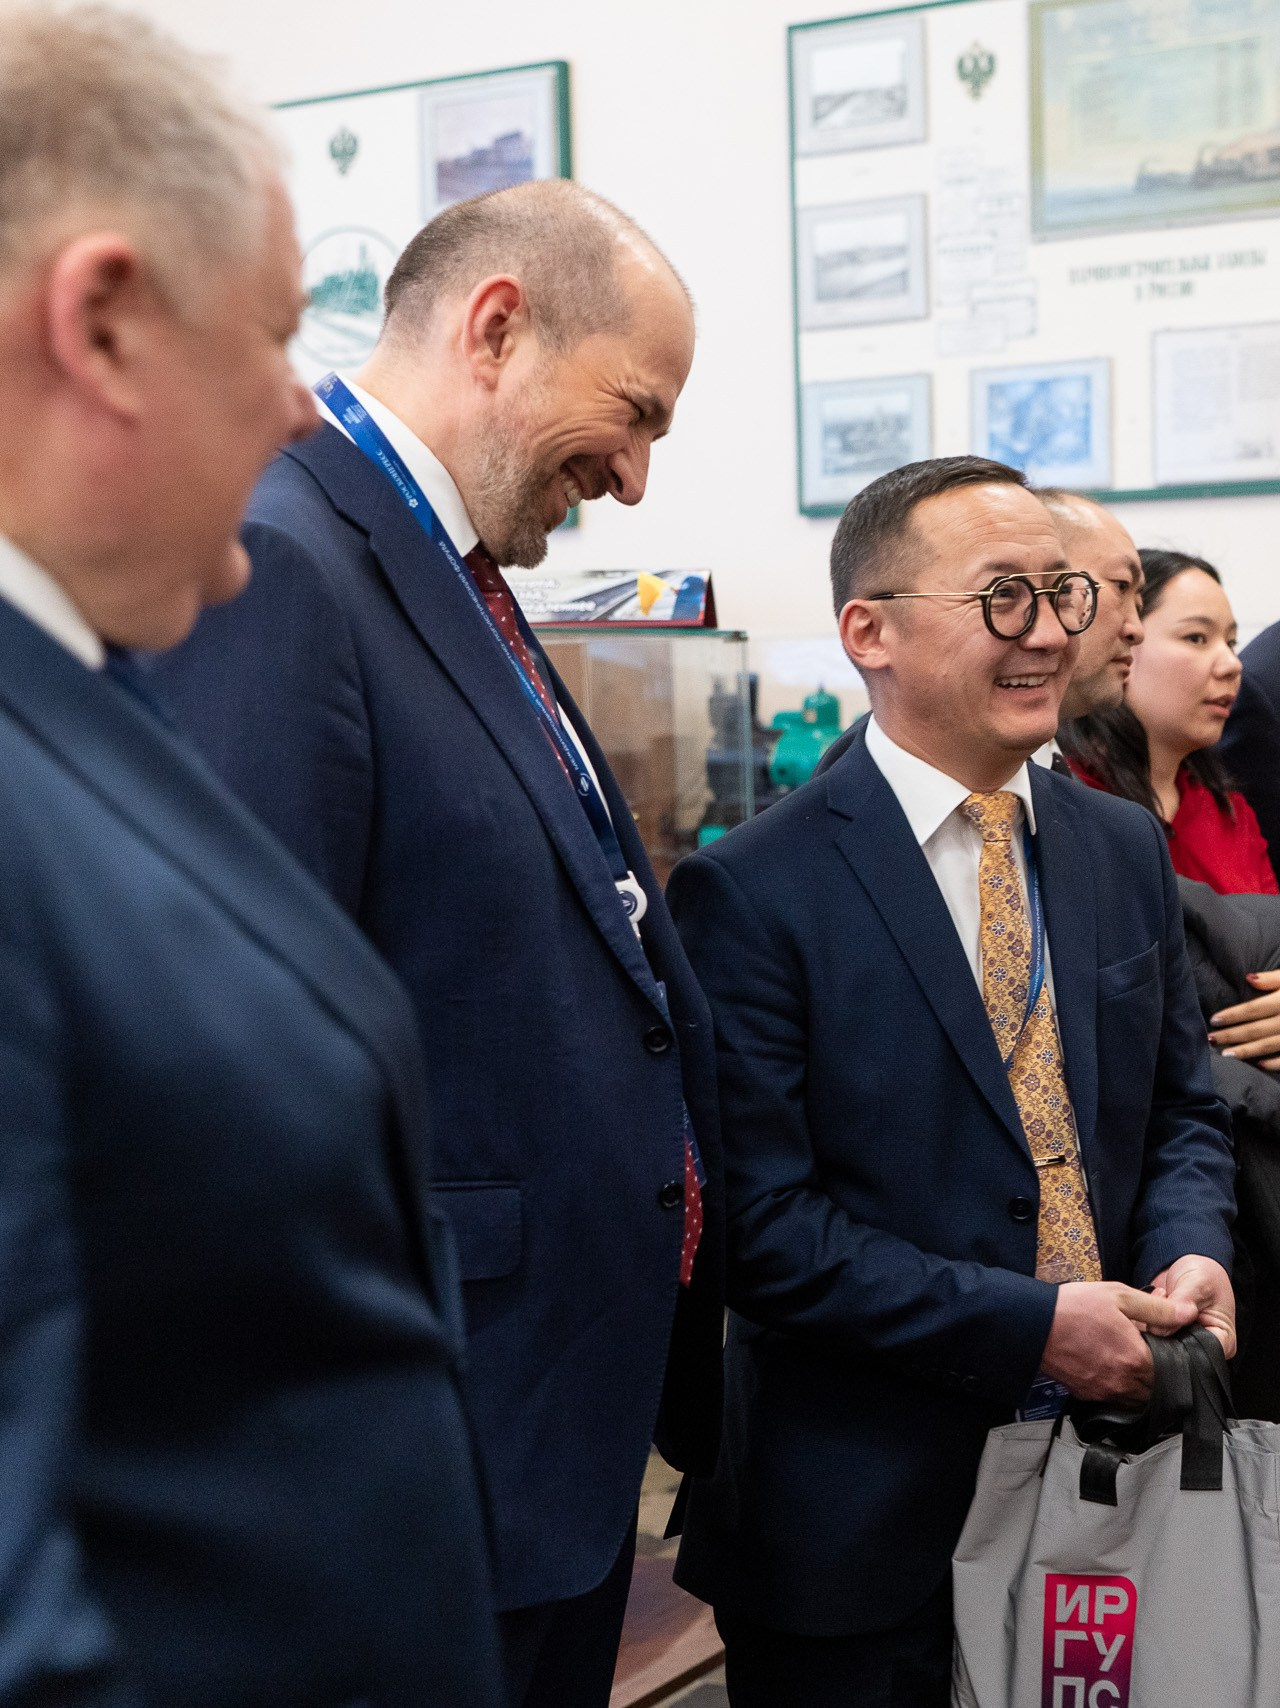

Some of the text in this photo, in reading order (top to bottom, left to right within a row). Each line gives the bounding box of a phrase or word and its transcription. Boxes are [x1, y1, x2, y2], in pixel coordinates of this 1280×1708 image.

[1055, 1584, 1129, 1624] ИР
[1053, 1629, 1126, 1672] ГУ
[1052, 1675, 1121, 1708] ПС
